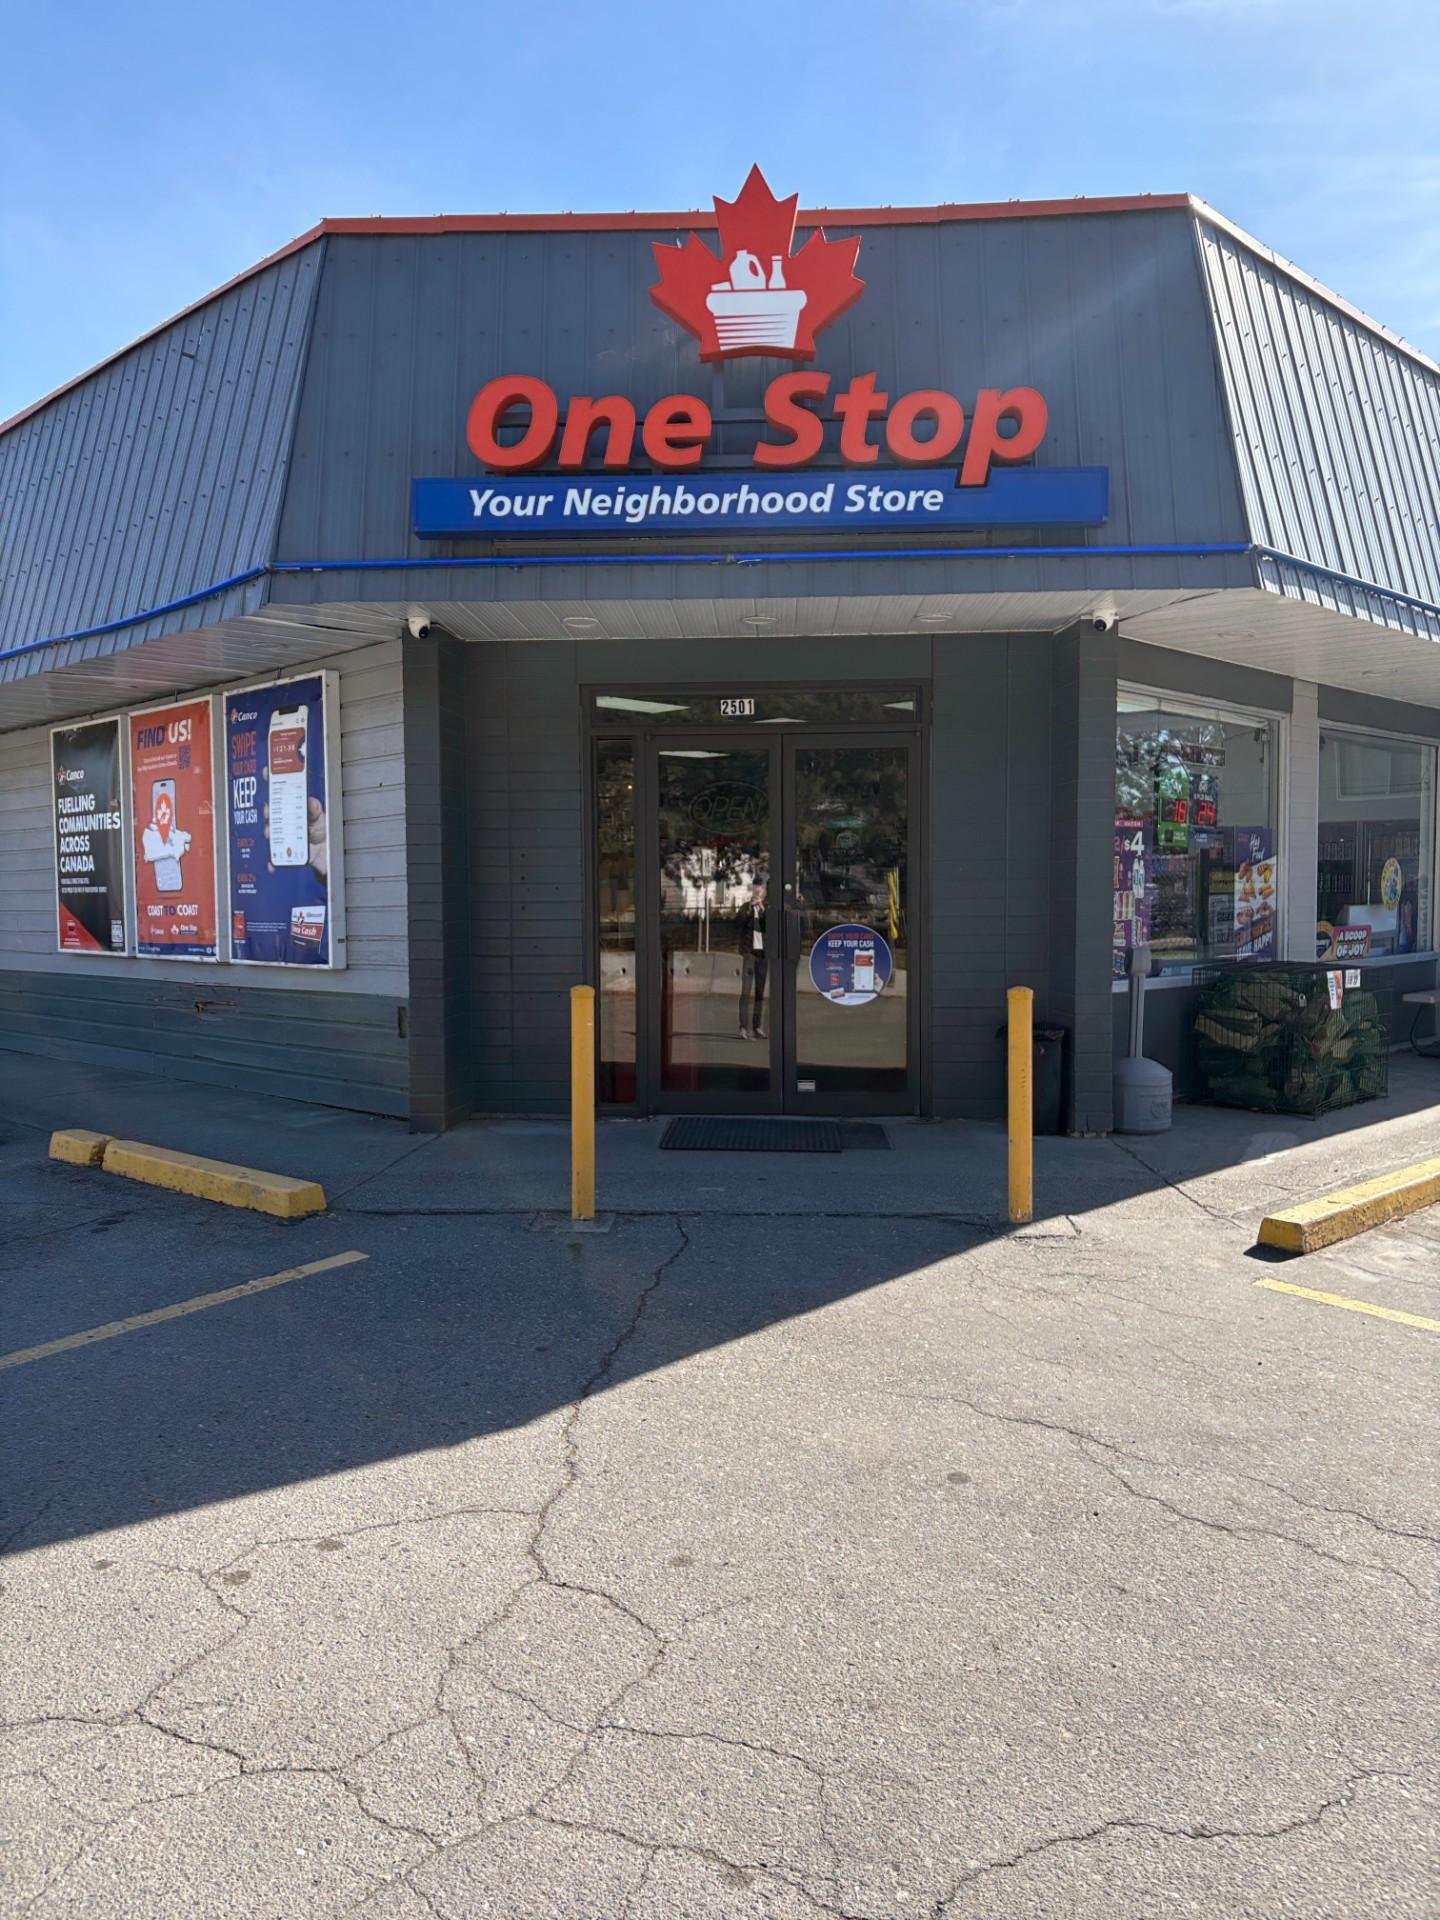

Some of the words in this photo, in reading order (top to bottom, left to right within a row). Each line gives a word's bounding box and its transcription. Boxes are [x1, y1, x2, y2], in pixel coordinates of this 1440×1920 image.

[466, 373, 712, 474] One
[753, 371, 1048, 486] Stop
[469, 489, 553, 517] Your
[563, 483, 836, 523] Neighborhood
[844, 484, 944, 513] Store
[722, 699, 753, 715] 2501
[238, 711, 258, 722] Canco
[137, 725, 165, 751] FIND
[168, 718, 192, 744] US!
[232, 731, 256, 759] SWIPE
[66, 769, 85, 781] Canco
[233, 776, 257, 809] KEEP
[58, 794, 95, 814] FUELLING
[693, 794, 759, 821] OPEN
[59, 812, 121, 834] COMMUNITIES
[233, 810, 245, 825] YOUR
[245, 808, 258, 824] CASH
[60, 835, 90, 853] ACROSS
[60, 855, 95, 873] CANADA
[147, 904, 163, 916] COAST
[164, 905, 176, 916] TO
[177, 904, 198, 916] COAST
[301, 925, 317, 937] Cash
[1338, 932, 1344, 941] A
[1344, 929, 1367, 941] SCOOP
[828, 939, 842, 948] KEEP
[843, 940, 858, 948] YOUR
[859, 939, 874, 948] CASH
[1253, 931, 1272, 952] HAPPY
[1336, 944, 1350, 957] OF
[1350, 943, 1365, 956] JOY
